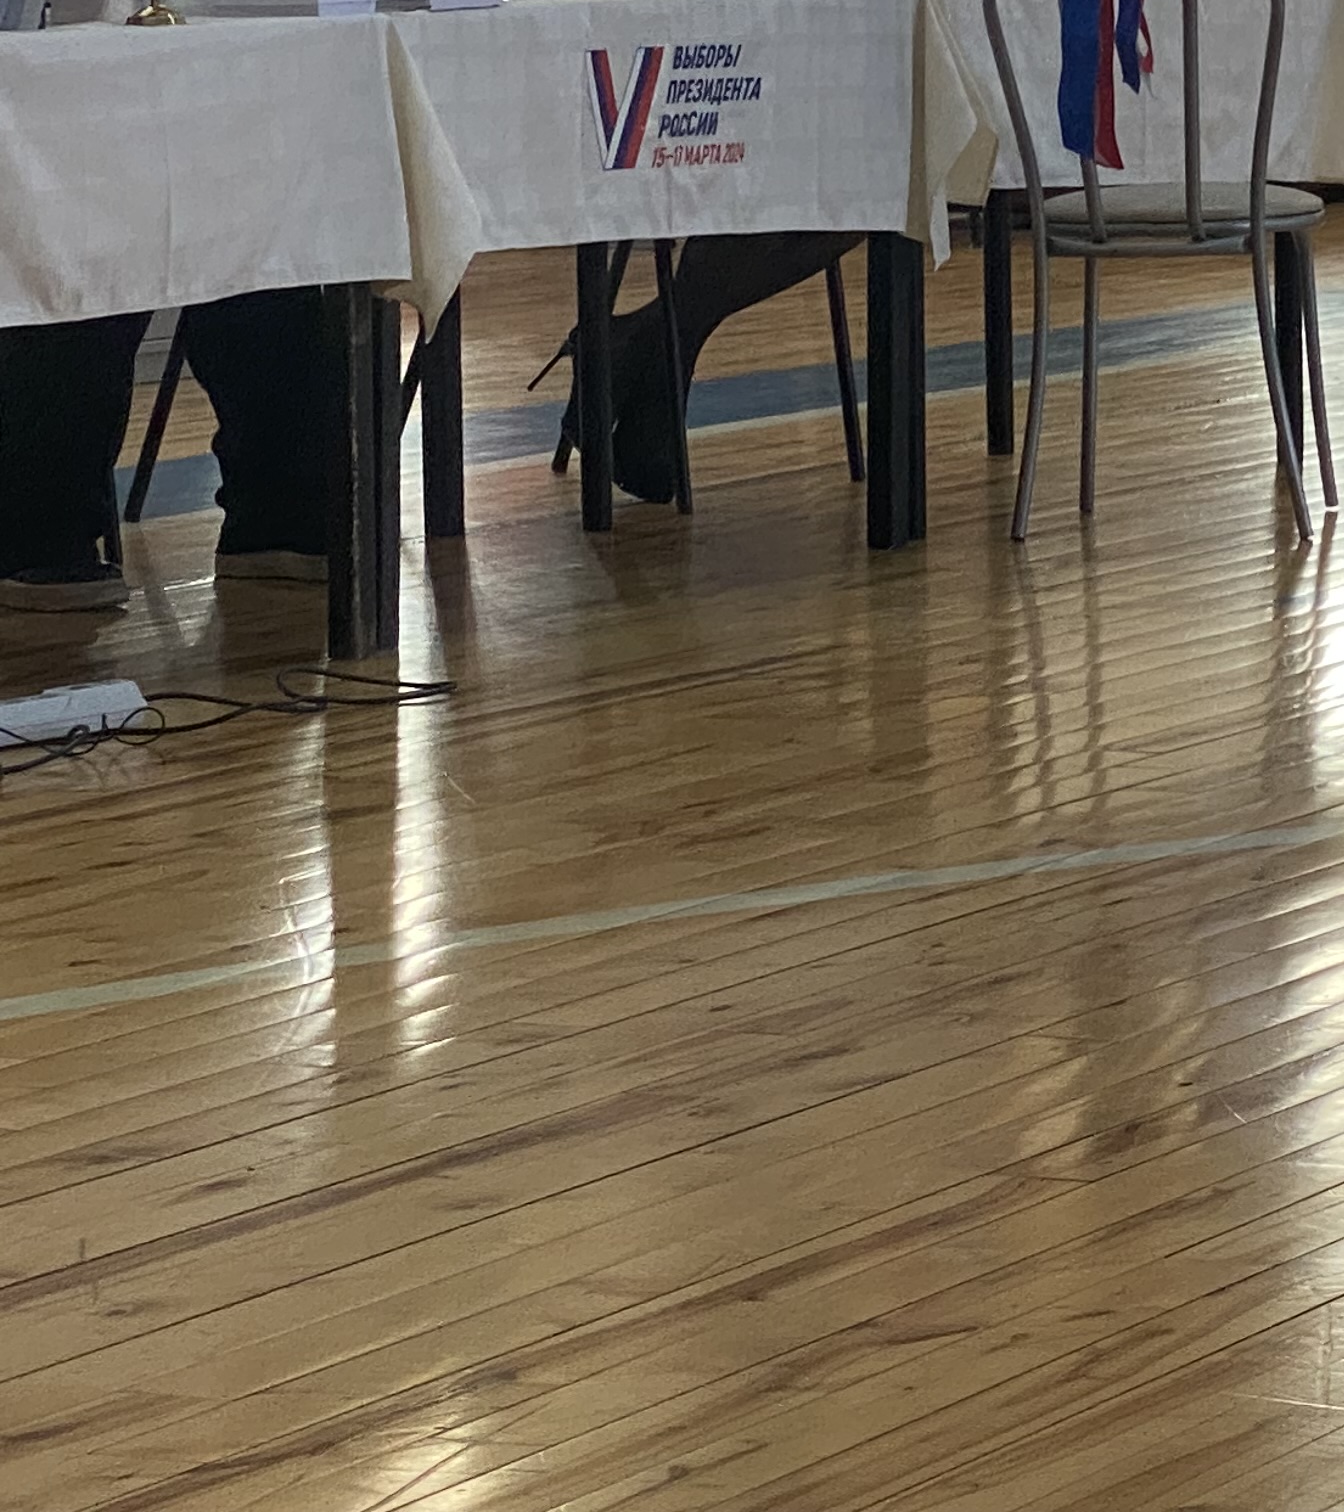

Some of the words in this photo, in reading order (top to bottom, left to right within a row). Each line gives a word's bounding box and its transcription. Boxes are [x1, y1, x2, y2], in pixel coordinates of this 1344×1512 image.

[673, 44, 742, 69] ВЫБОРЫ
[666, 77, 762, 105] ПРЕЗИДЕНТА
[658, 111, 719, 138] РОССИИ
[684, 144, 721, 166] МАРТА
